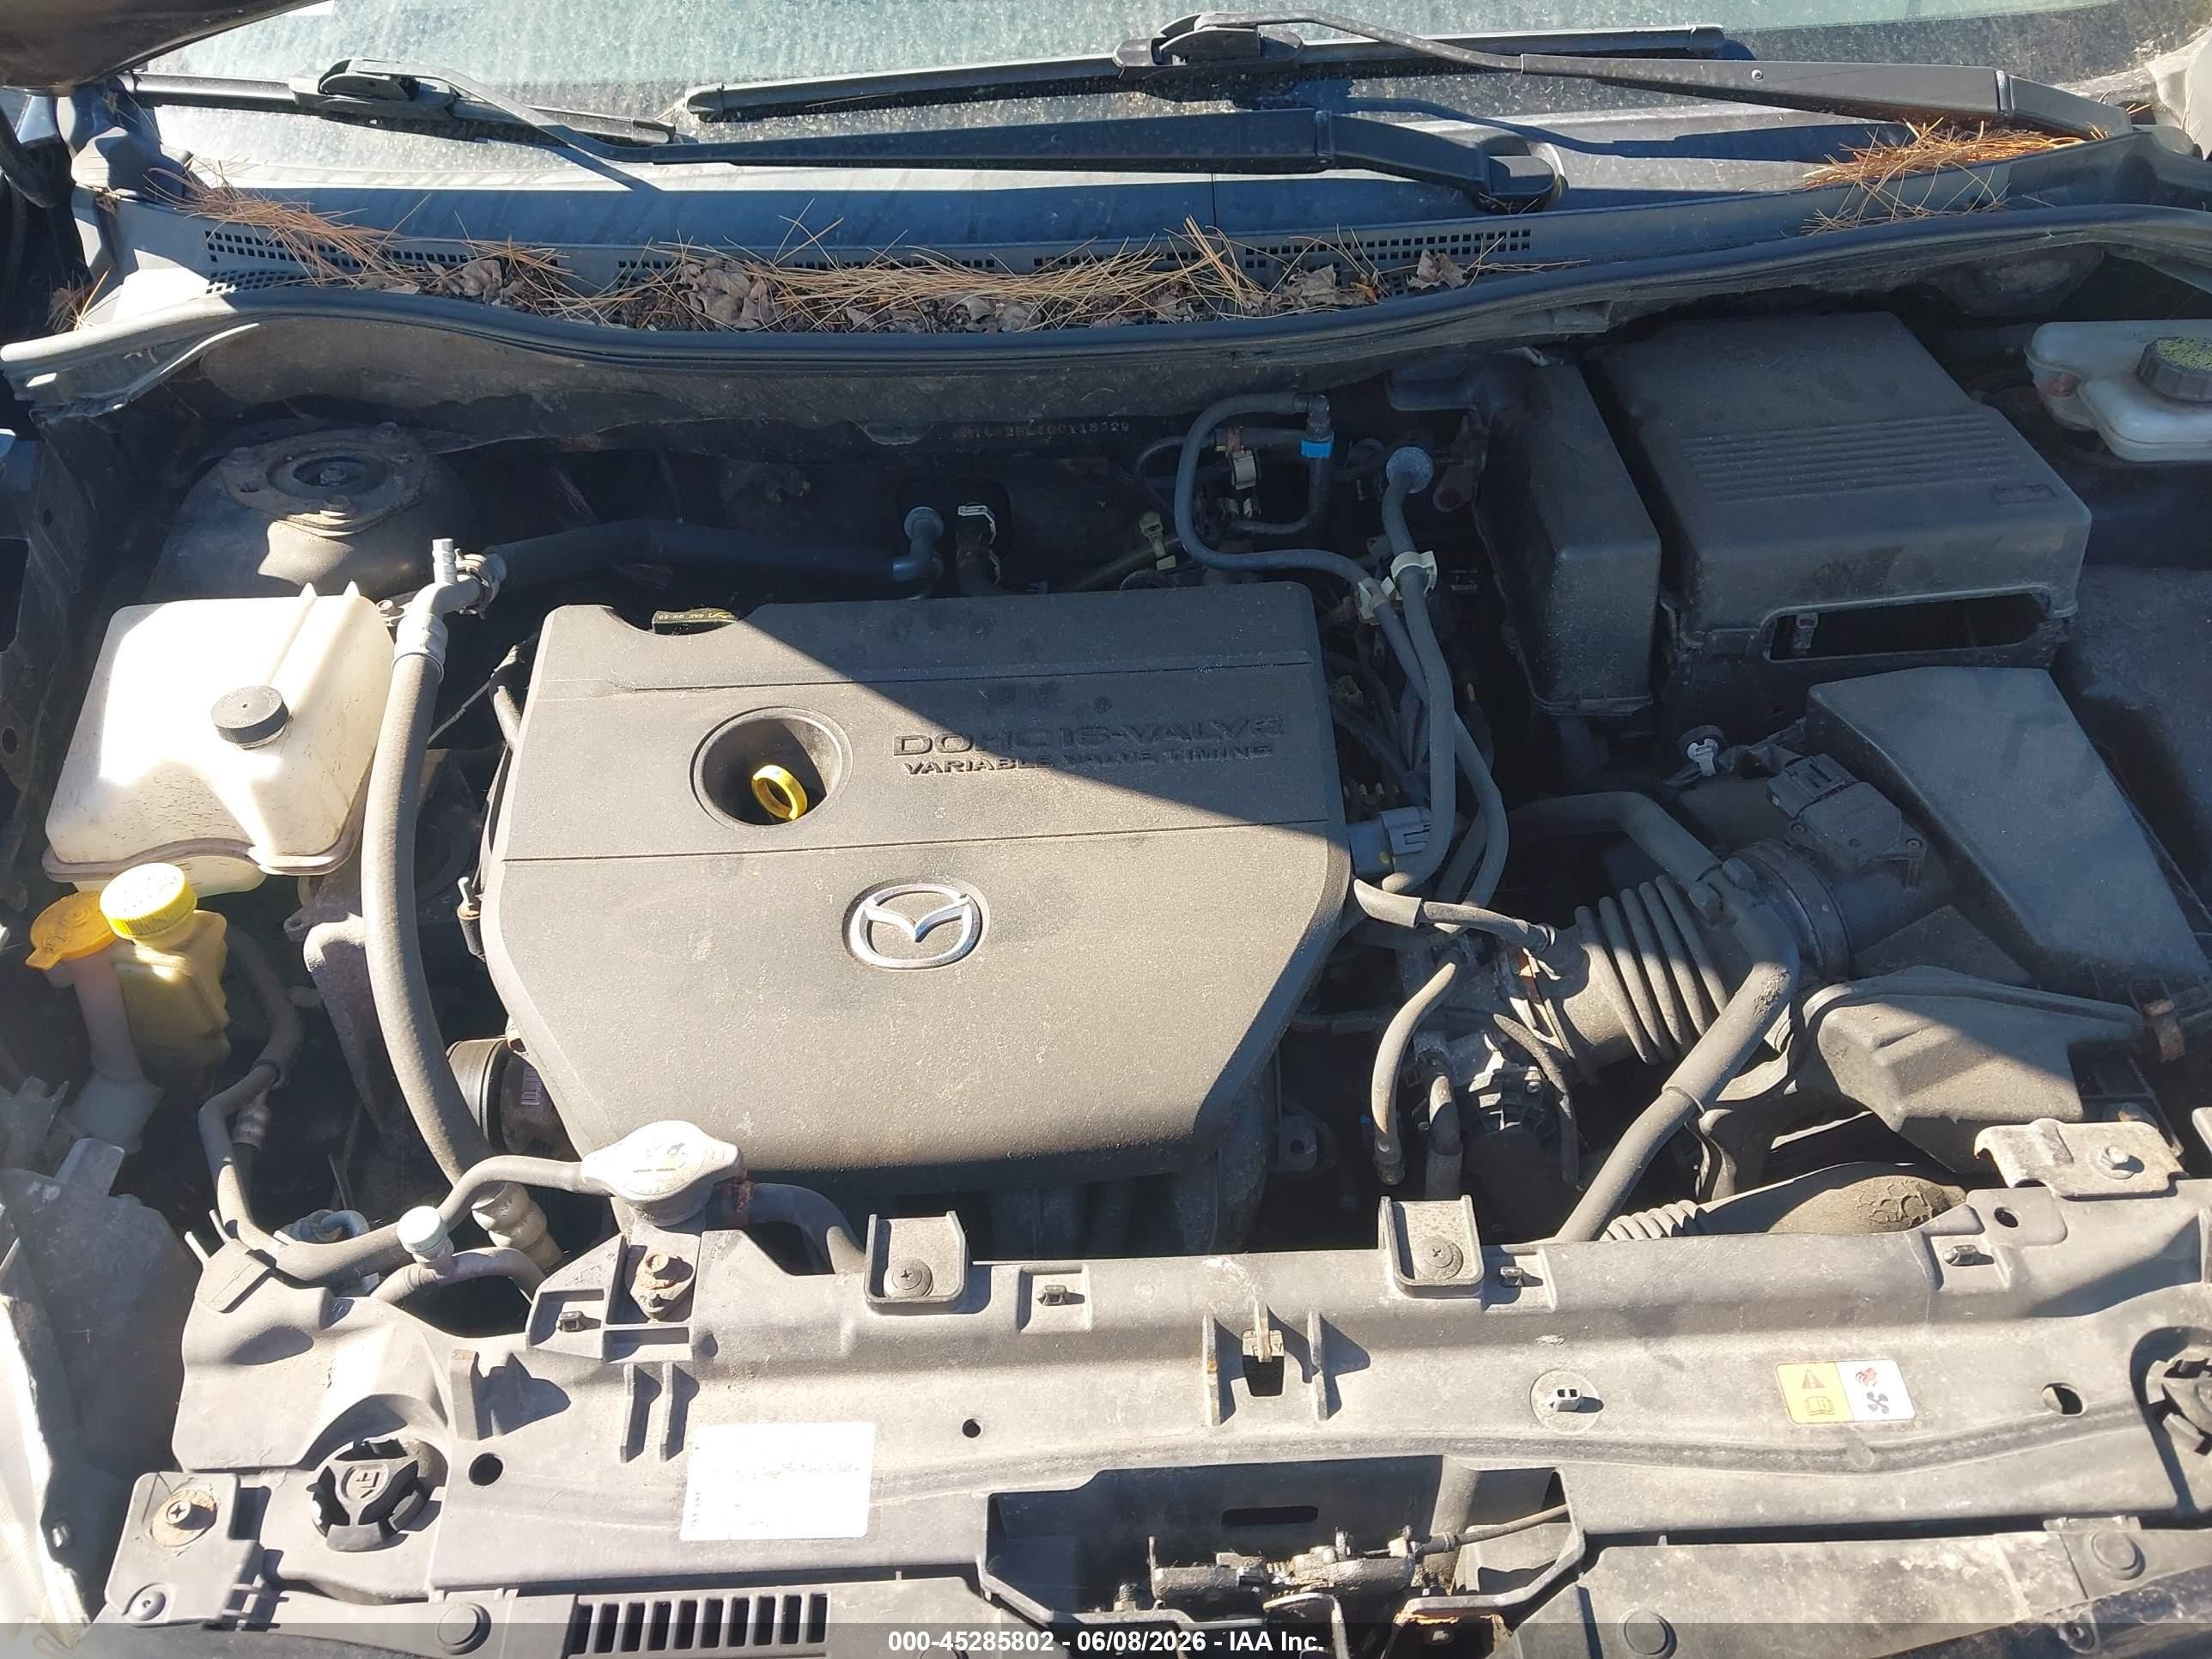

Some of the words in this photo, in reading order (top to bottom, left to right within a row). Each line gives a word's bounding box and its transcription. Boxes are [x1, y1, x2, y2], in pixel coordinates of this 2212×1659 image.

[893, 727, 1048, 756] DOHC
[1059, 717, 1284, 750] 16-VALVE
[904, 754, 1054, 775] VARIABLE
[1063, 750, 1156, 769] VALVE
[1165, 742, 1274, 763] TIMING
